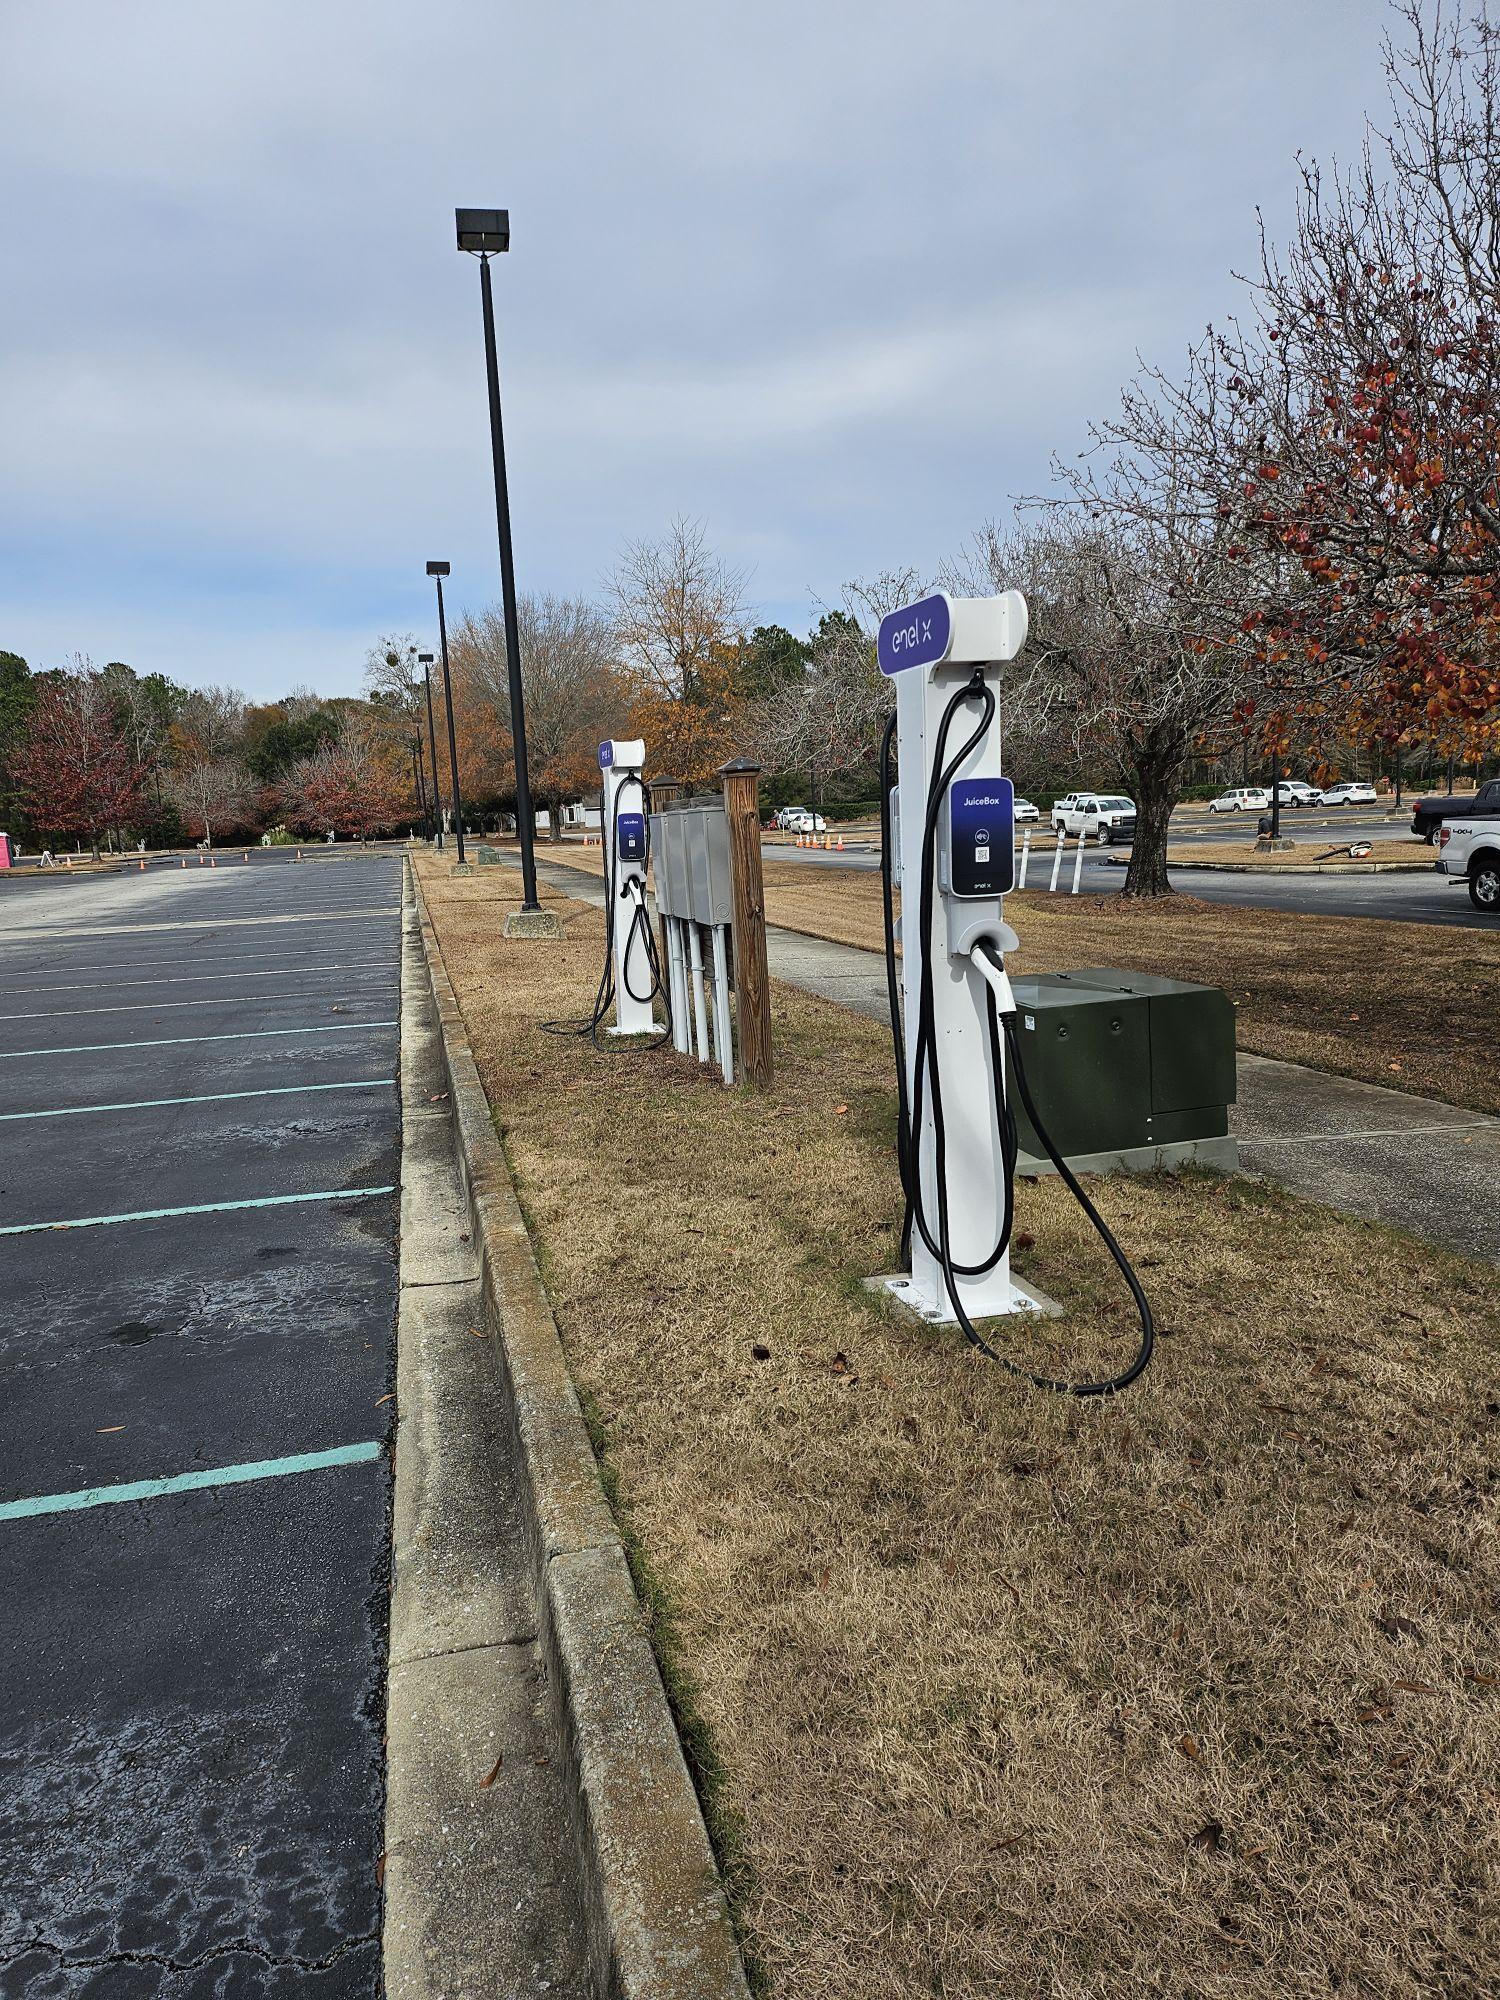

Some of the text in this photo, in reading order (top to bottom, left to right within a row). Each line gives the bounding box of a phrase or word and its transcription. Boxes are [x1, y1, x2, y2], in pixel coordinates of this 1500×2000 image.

[892, 617, 932, 653] enel x
[963, 796, 1000, 806] JuiceBox
